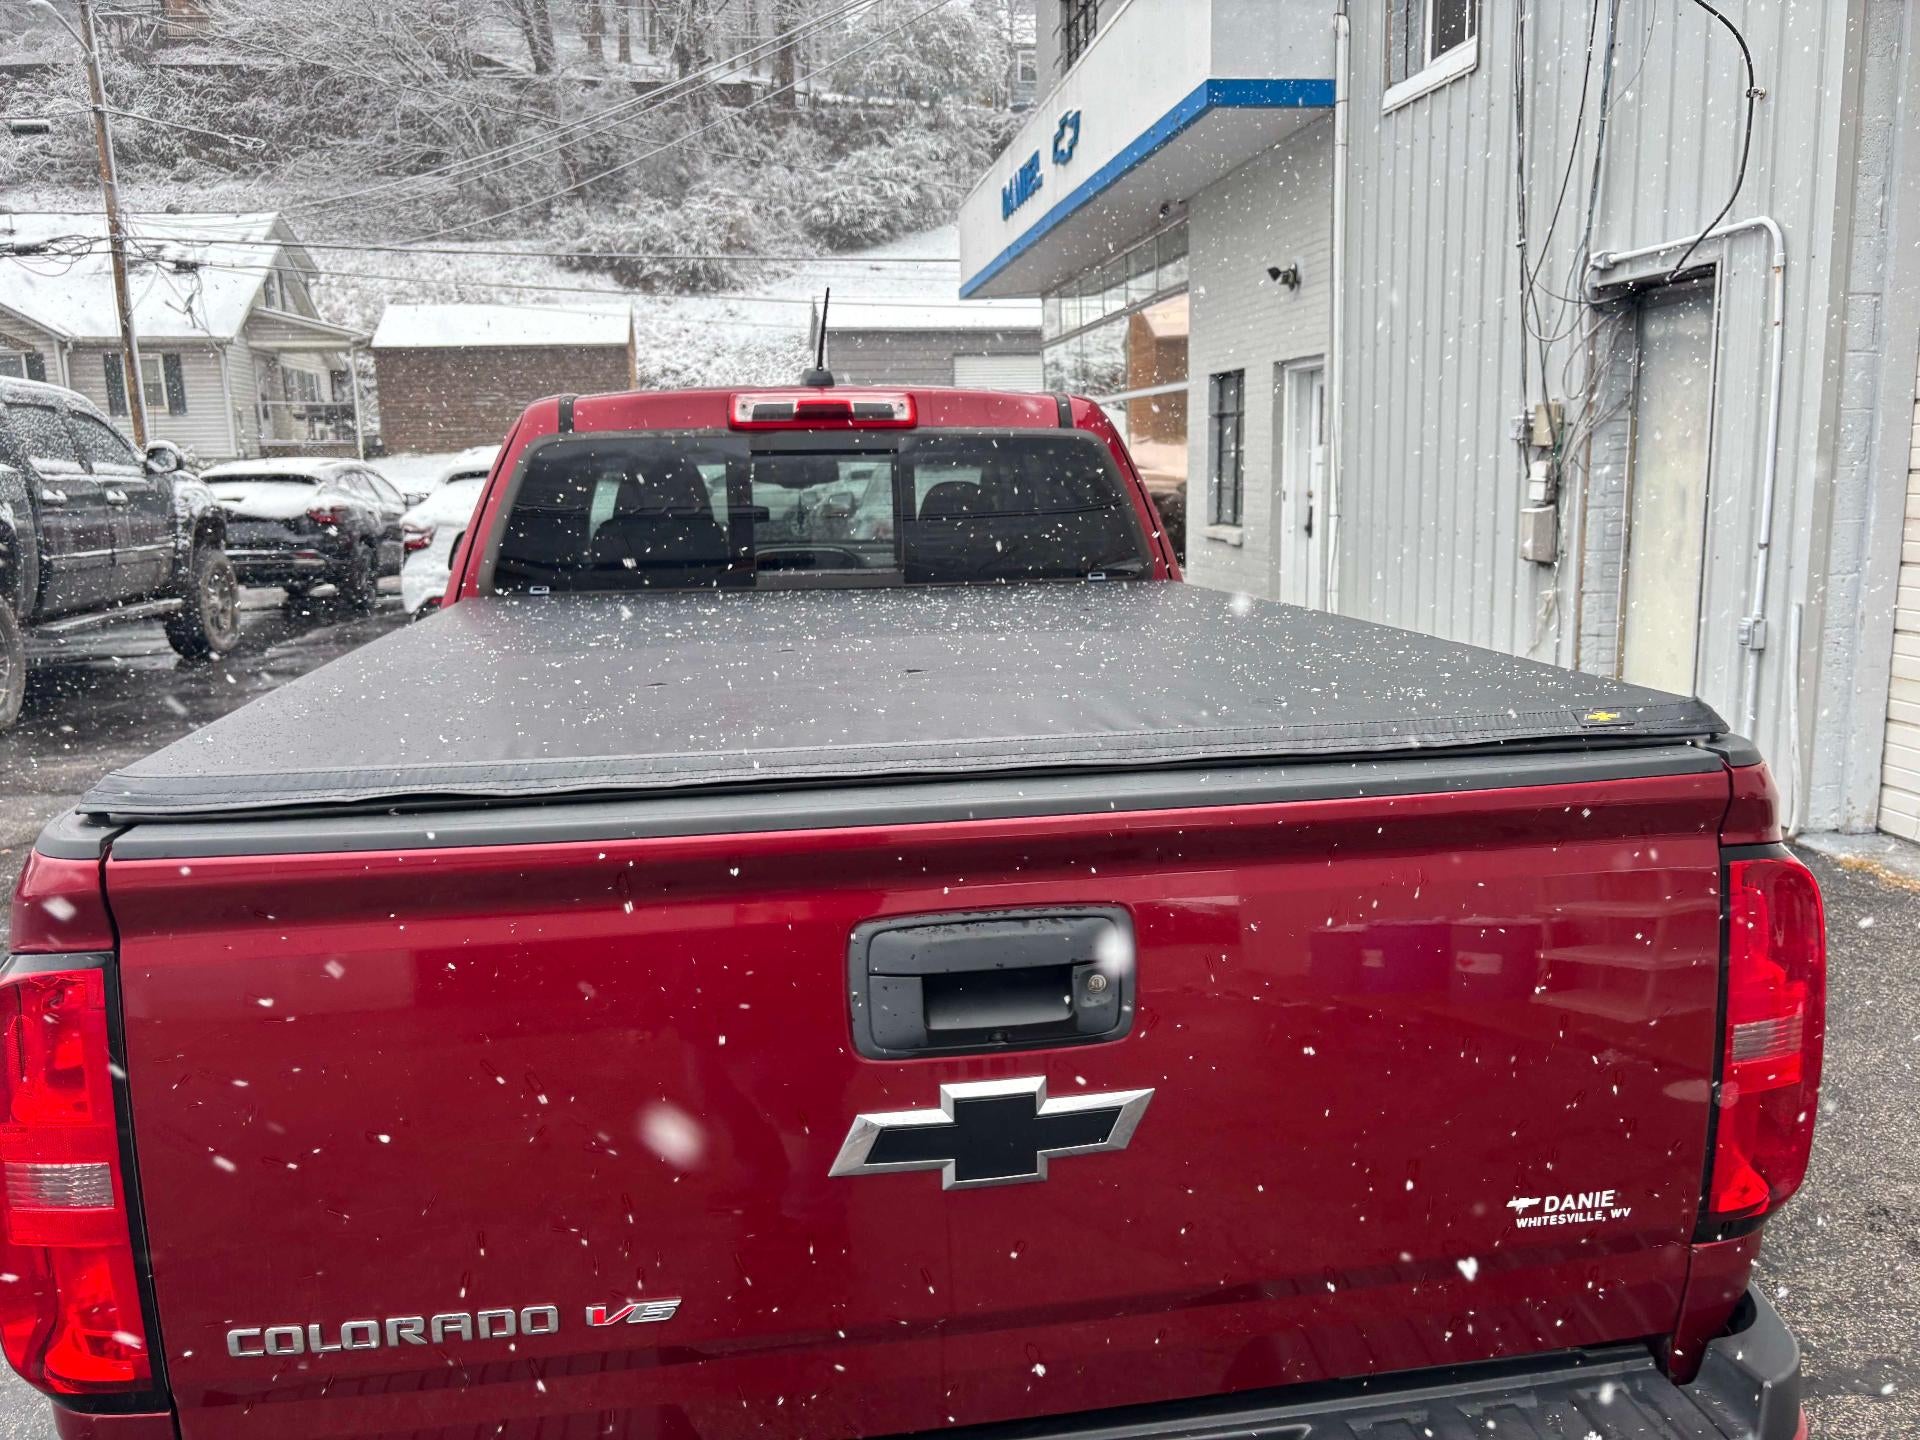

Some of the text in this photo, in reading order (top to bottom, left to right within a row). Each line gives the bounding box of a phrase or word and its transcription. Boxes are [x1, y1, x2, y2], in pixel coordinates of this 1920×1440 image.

[1544, 1189, 1616, 1213] DANIE
[1516, 1207, 1631, 1229] WHITESVILLE, WV
[226, 1297, 682, 1357] COLORADO V6
